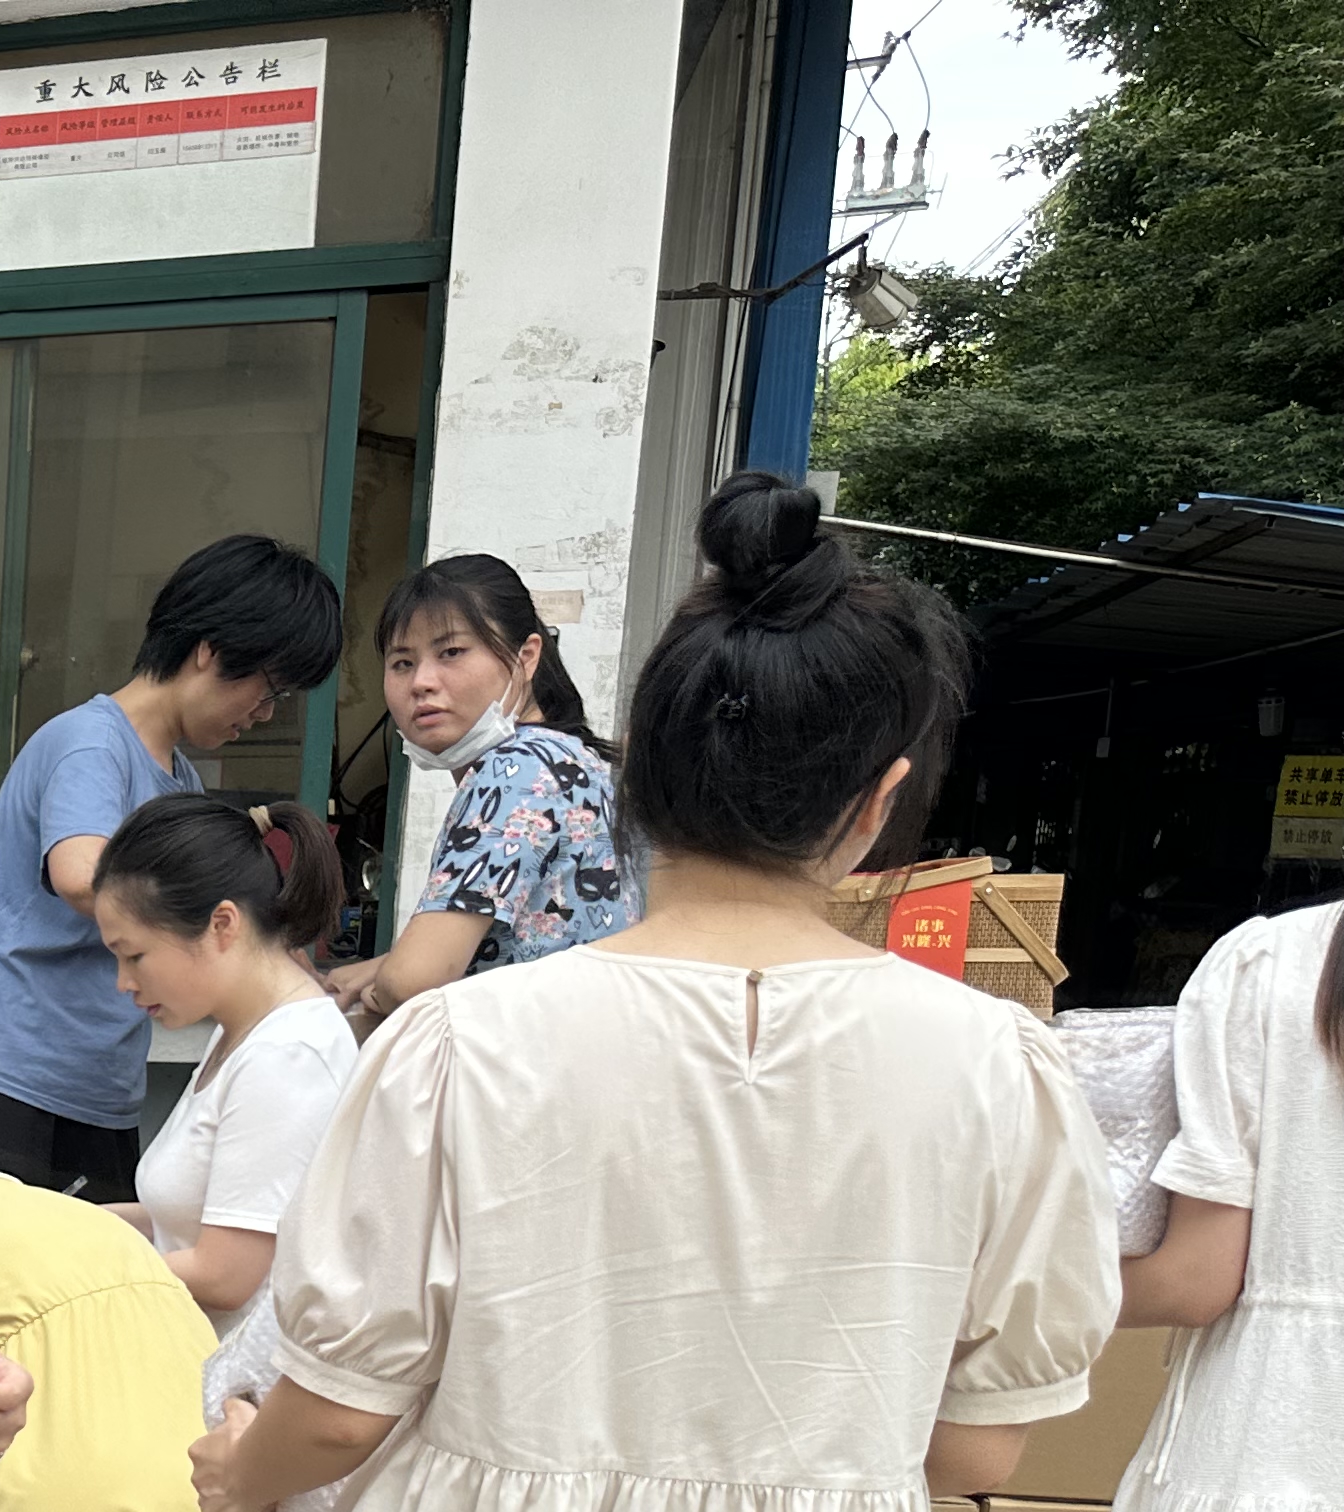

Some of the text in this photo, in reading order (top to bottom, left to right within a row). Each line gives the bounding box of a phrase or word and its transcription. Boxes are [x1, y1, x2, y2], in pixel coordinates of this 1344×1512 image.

[34, 59, 281, 103] 重大风险公告栏
[1283, 789, 1343, 807] 禁止停放
